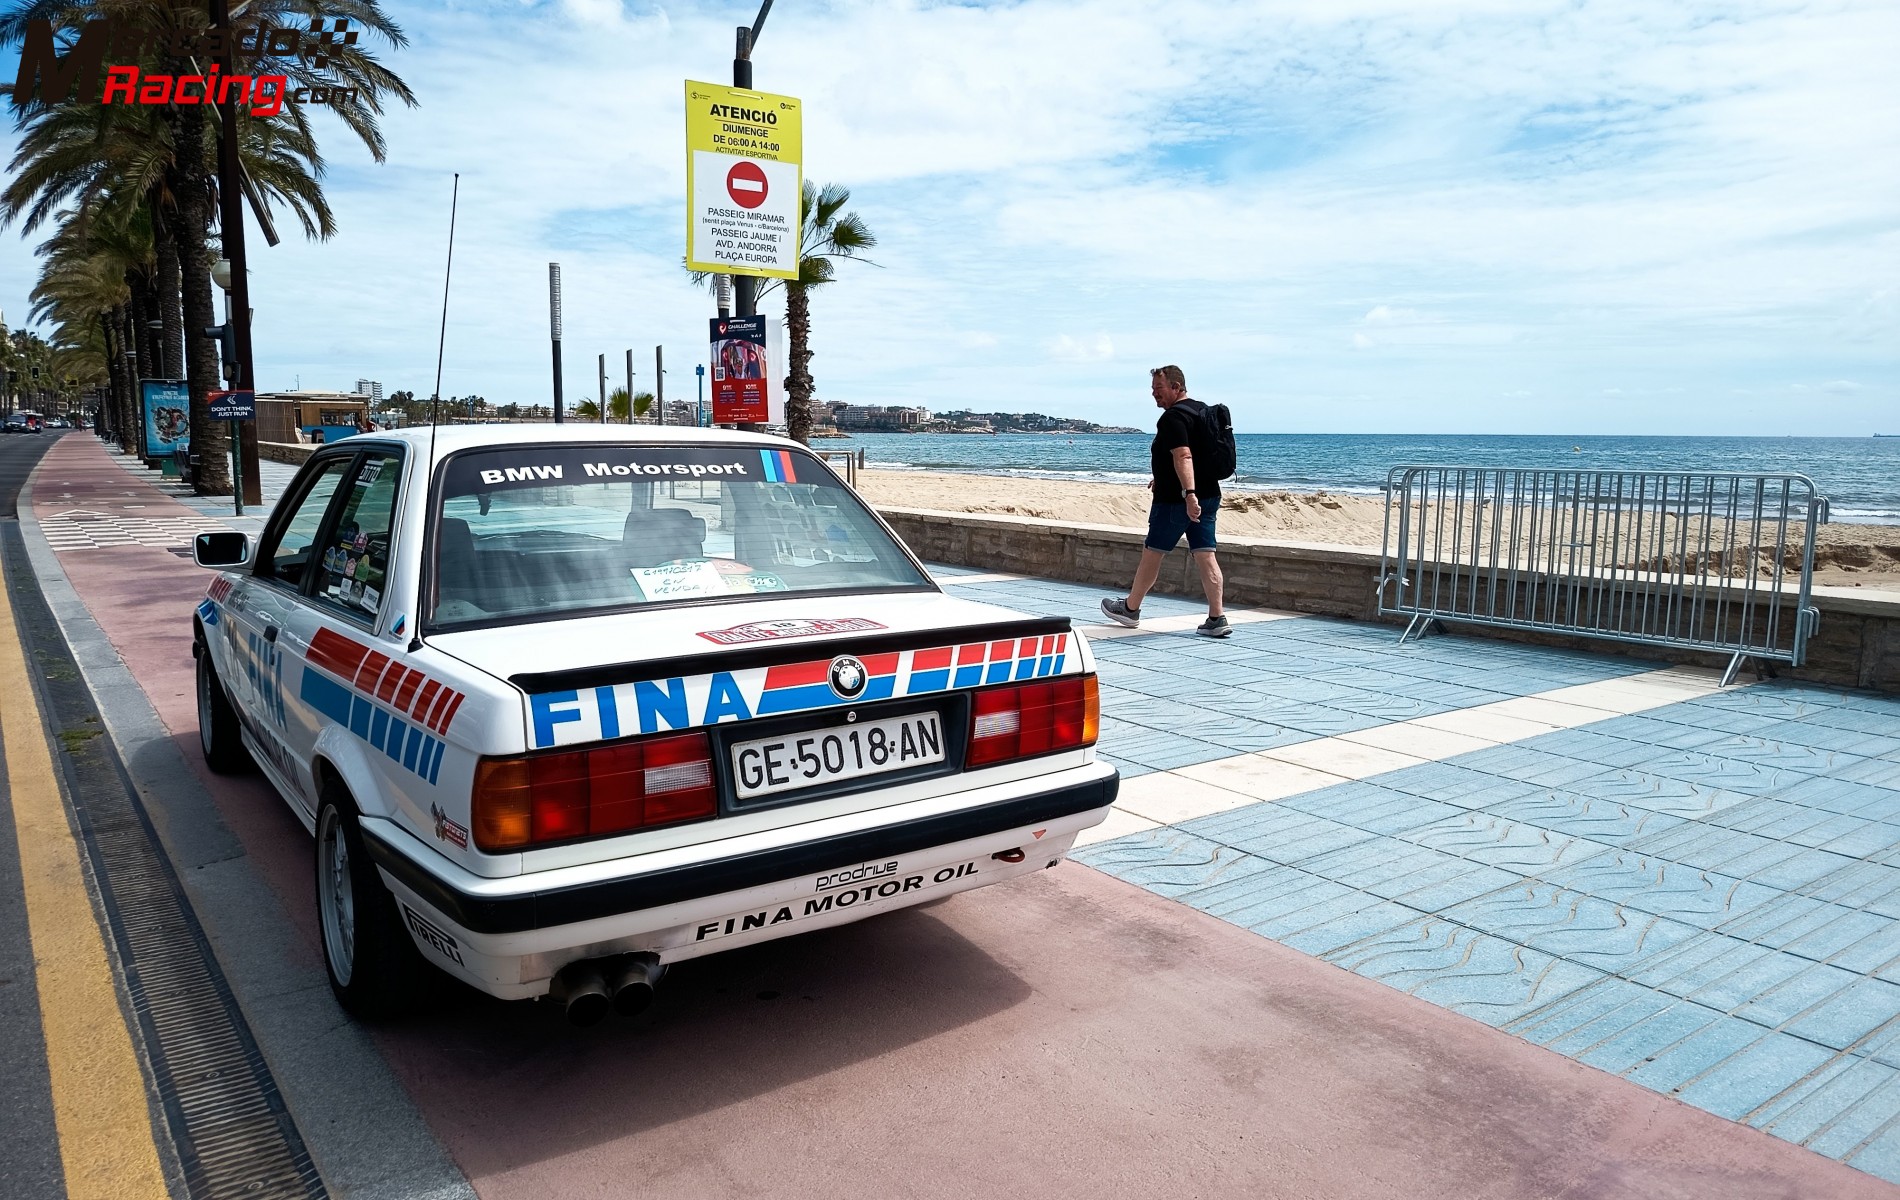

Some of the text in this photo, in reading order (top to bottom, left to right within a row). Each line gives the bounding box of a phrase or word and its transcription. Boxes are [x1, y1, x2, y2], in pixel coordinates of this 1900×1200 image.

[710, 104, 778, 125] ATENCIÓ
[722, 123, 769, 138] DIUMENGE
[713, 134, 780, 152] DE 06:00 A 14:00
[715, 146, 779, 161] ACTIVITAT ESPORTIVA
[708, 207, 785, 224] PASSEIG MIRAMAR
[711, 227, 749, 240] PASSEIG
[750, 232, 778, 243] JAUME
[715, 239, 778, 253] AVD. ANDORRA
[715, 250, 778, 264] PLAÇA EUROPA
[479, 461, 747, 485] BMW Motorsport
[833, 659, 862, 673] BMW
[529, 670, 753, 748] FINA
[815, 860, 898, 892] prodrive
[695, 862, 979, 941] FINA MOTOR OIL
[402, 902, 465, 968] PIRELLI
